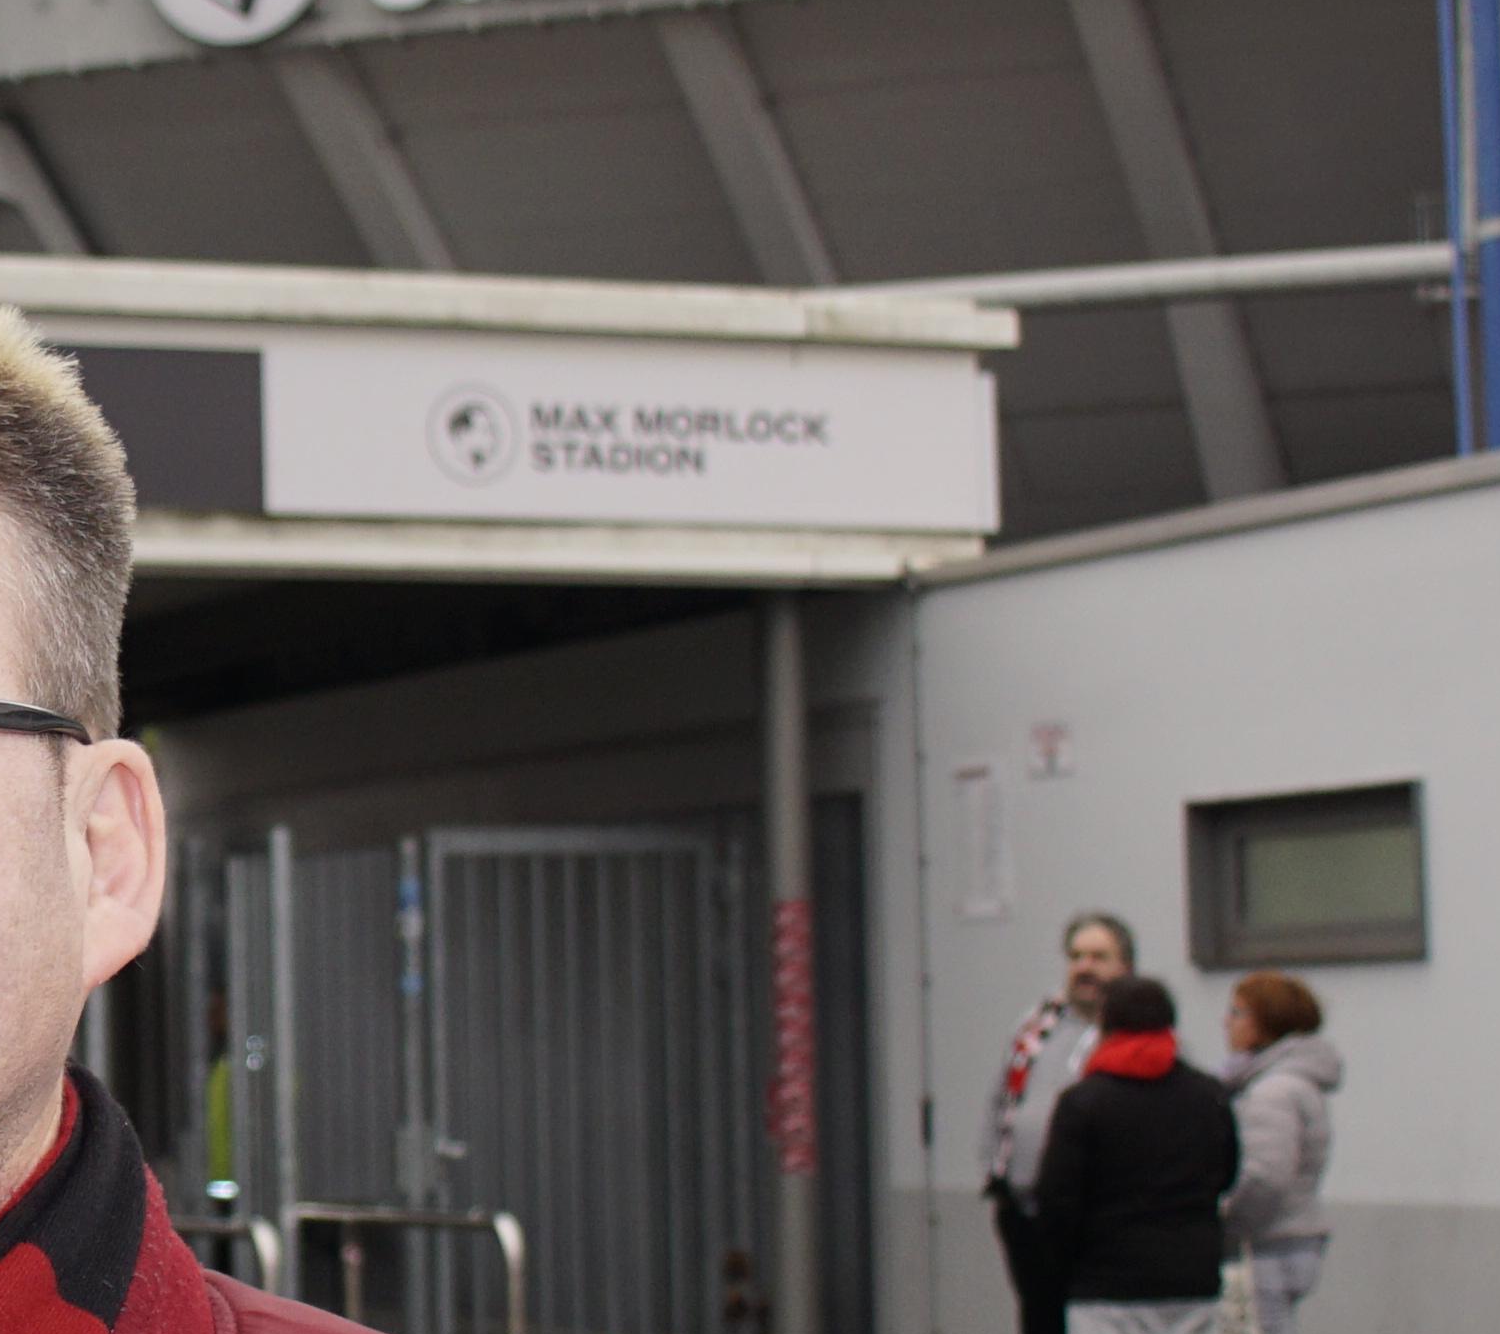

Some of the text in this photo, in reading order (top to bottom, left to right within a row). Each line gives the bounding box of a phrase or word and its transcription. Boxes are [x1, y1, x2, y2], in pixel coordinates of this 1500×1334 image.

[530, 403, 828, 444] MAX MORLOCK
[530, 441, 704, 475] STADION
